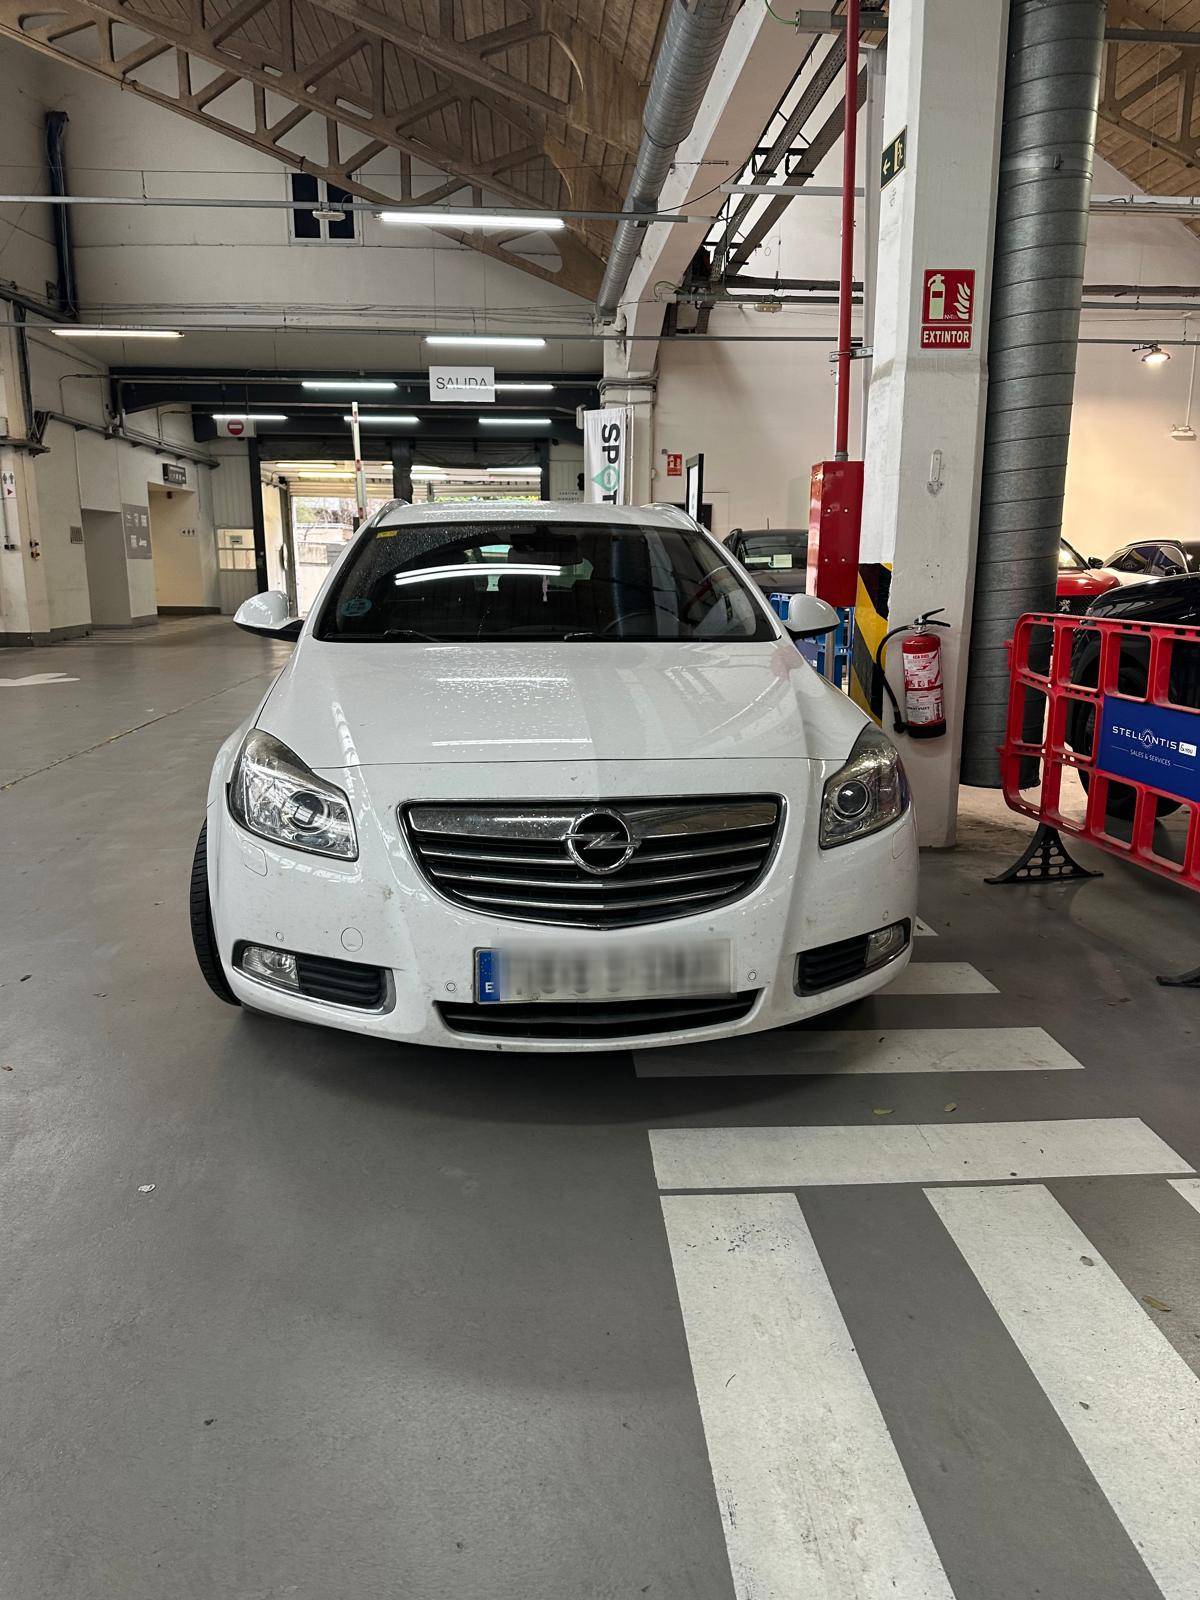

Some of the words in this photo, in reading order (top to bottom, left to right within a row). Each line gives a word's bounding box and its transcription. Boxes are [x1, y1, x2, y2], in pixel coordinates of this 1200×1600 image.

[923, 330, 969, 343] EXTINTOR
[436, 377, 488, 390] SALIDA
[1112, 725, 1177, 750] STELLANTIS
[1130, 749, 1144, 759] SALES
[1149, 754, 1171, 767] SERVICES
[485, 981, 495, 993] E
